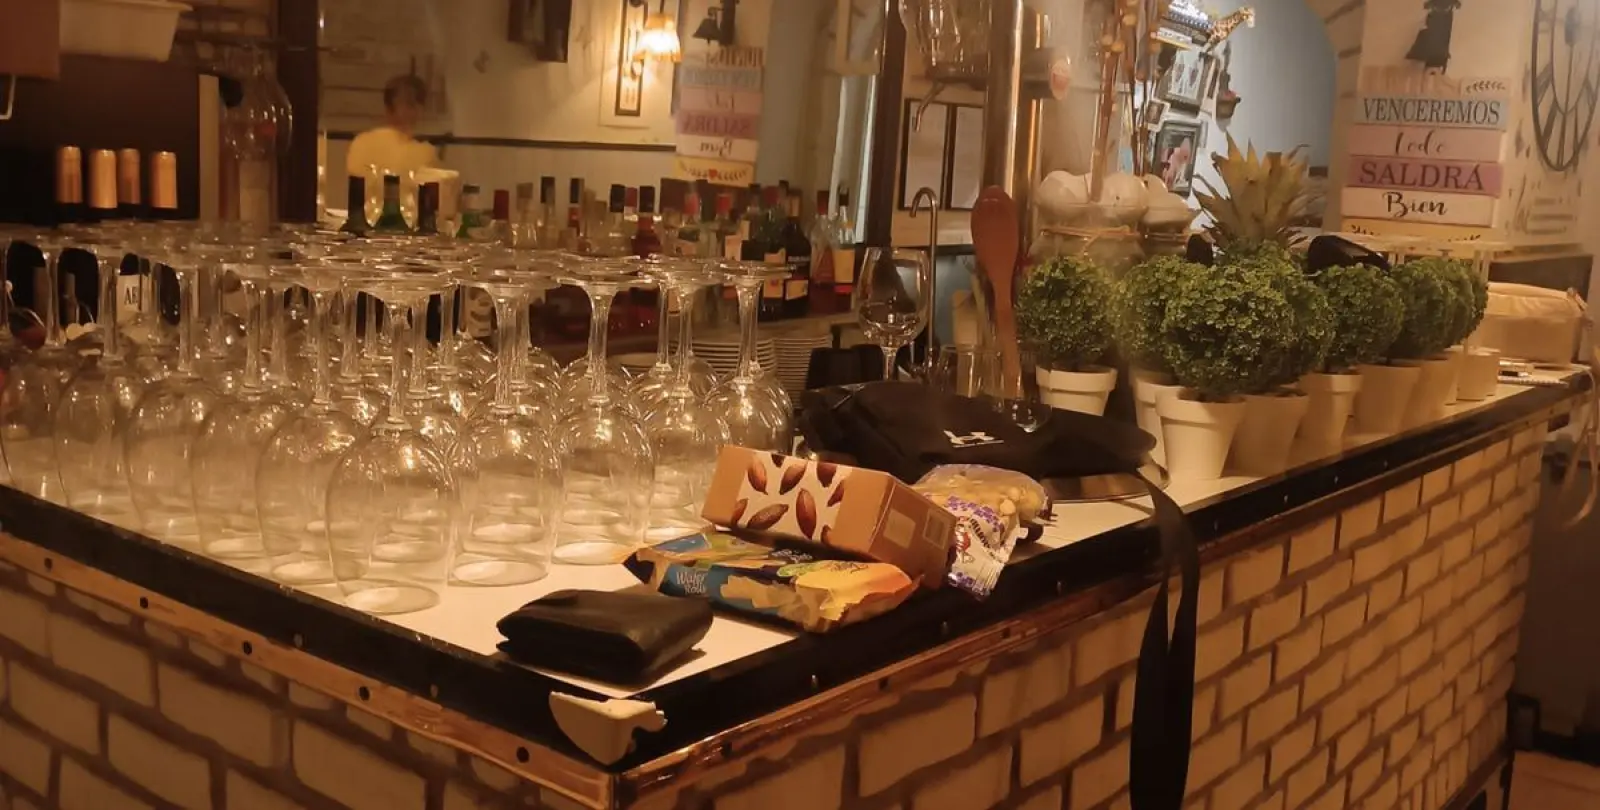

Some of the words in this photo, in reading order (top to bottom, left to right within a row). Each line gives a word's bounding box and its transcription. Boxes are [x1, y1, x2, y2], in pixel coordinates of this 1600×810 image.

[1363, 98, 1501, 125] VENCEREMOS
[1359, 159, 1484, 191] SALDRÁ
[1382, 191, 1447, 218] Bien
